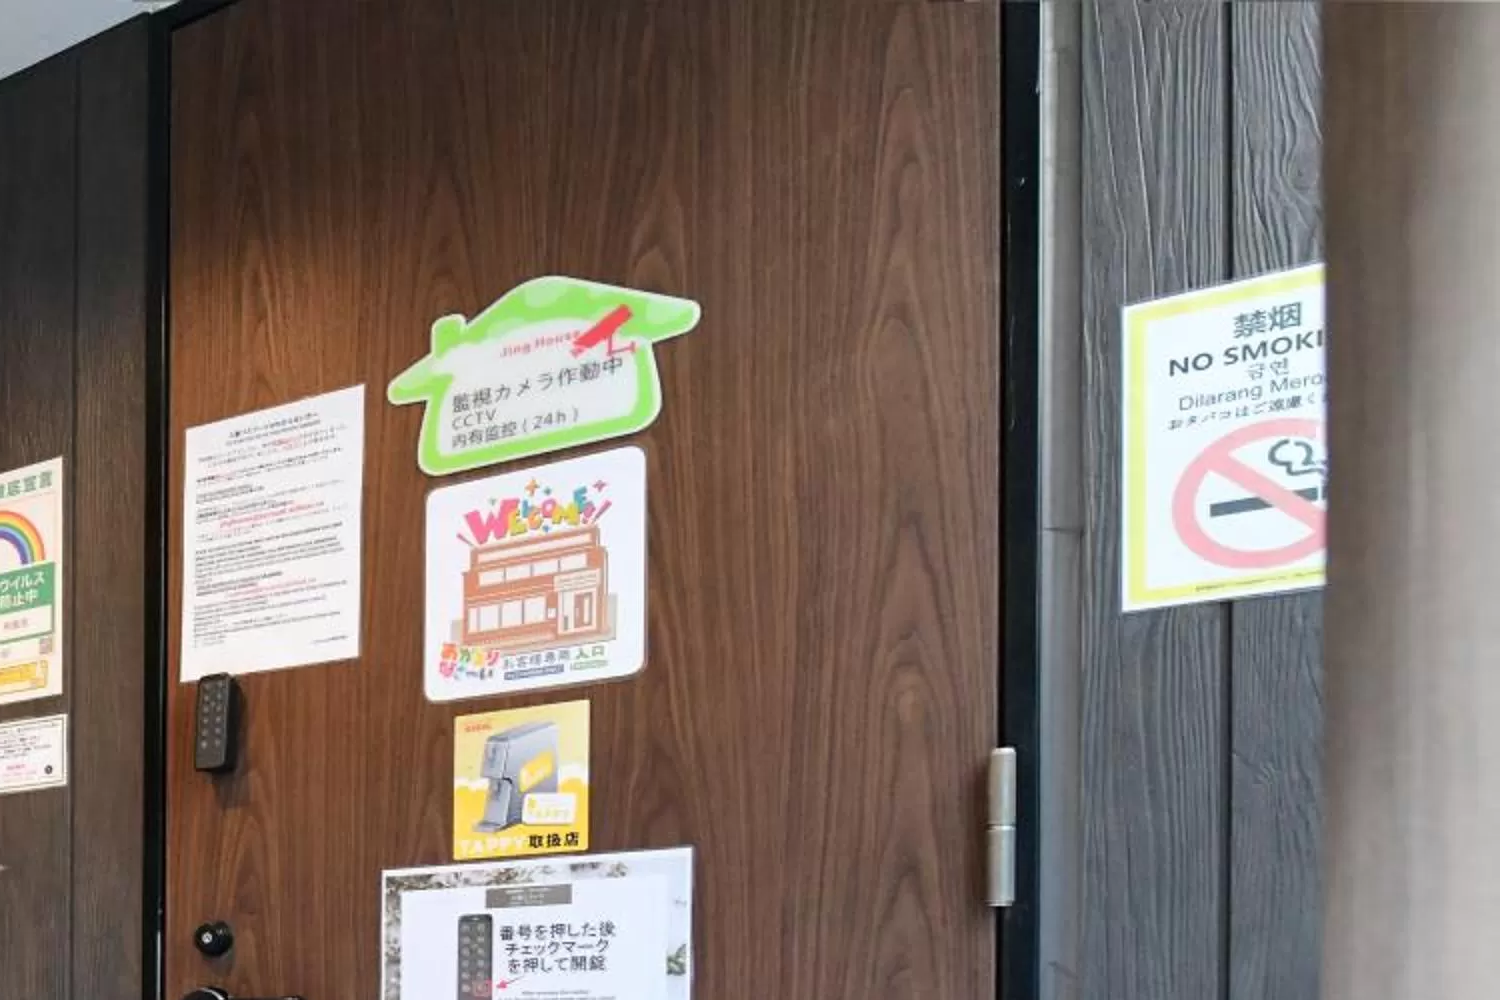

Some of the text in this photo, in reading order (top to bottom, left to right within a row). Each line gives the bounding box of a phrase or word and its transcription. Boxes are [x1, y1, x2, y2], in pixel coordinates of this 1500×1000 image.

[1233, 301, 1302, 339] 禁烟
[500, 342, 531, 357] Jing
[1169, 329, 1324, 376] NO SMOKI
[1247, 357, 1290, 381] 금연
[452, 357, 623, 414] 監視カメラ作動中
[1179, 385, 1263, 411] Dilarang
[452, 408, 496, 431] CCTV
[528, 832, 579, 848] 取扱店
[500, 920, 616, 941] 番号を押した後
[505, 938, 610, 956] チェックマーク
[507, 955, 608, 975] を押して開錠
